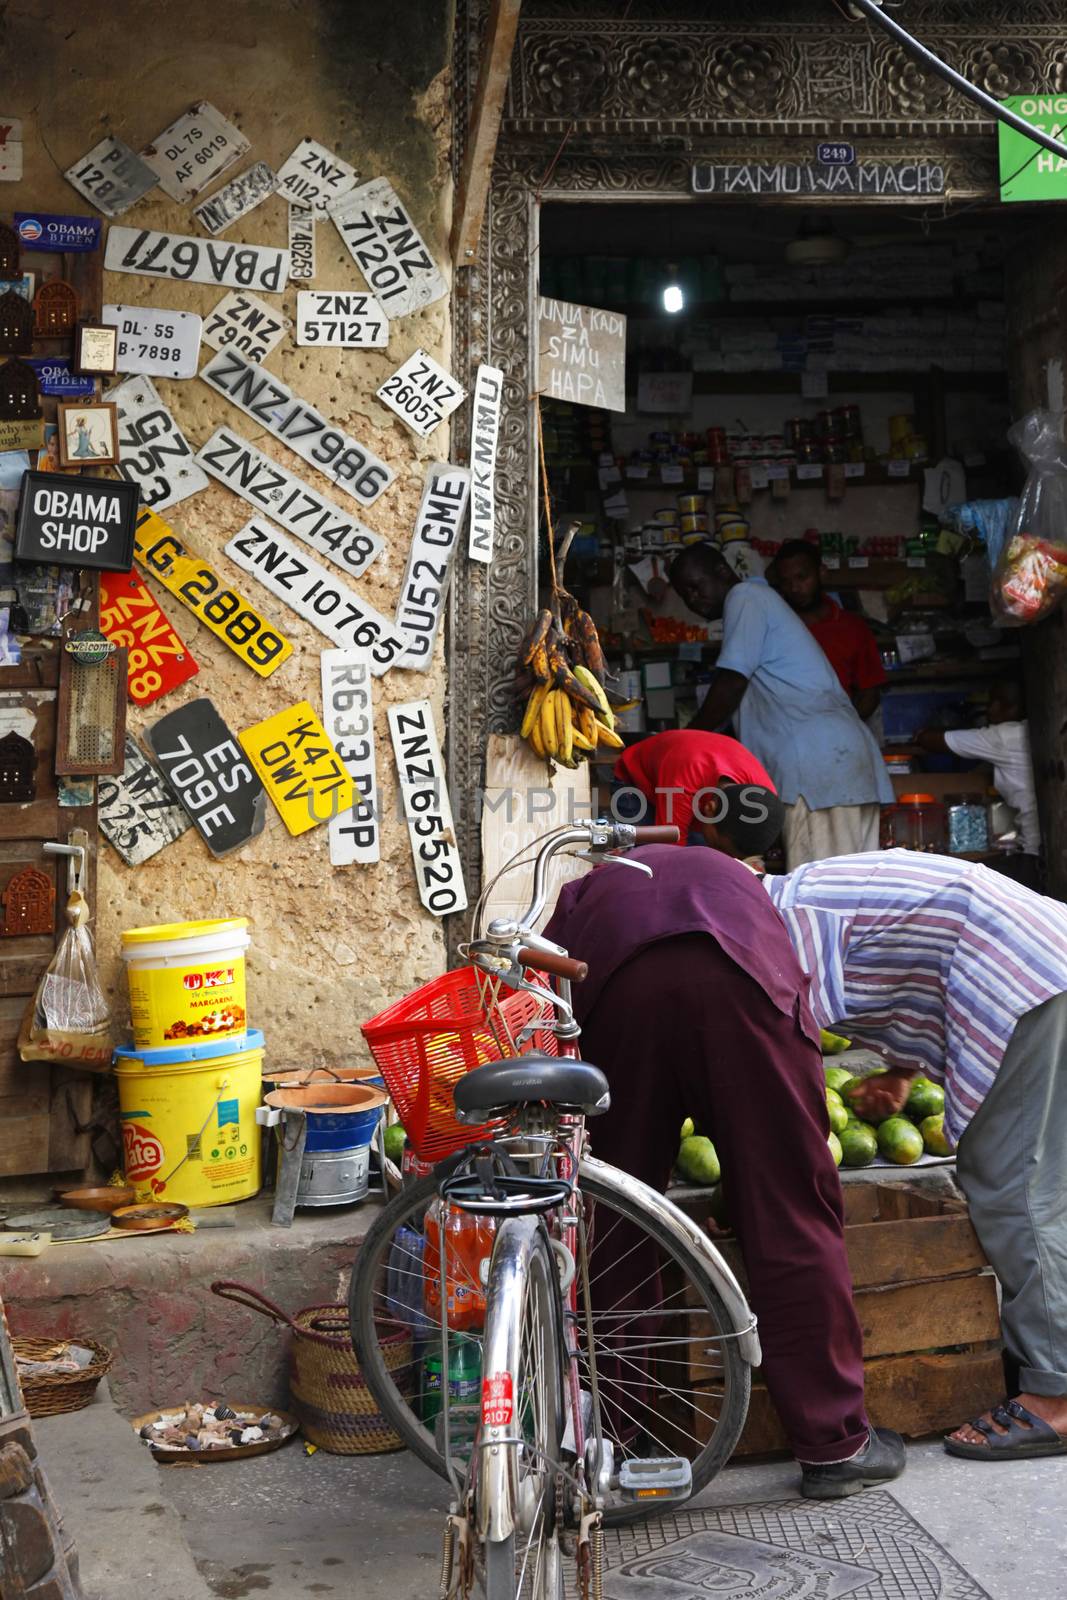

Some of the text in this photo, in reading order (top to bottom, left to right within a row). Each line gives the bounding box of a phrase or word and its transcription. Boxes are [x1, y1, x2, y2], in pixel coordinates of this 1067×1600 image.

[164, 127, 204, 162] DL 7S
[175, 134, 229, 183] AF 6019
[823, 147, 847, 160] 249
[300, 151, 346, 188] ZNZ
[691, 165, 800, 193] UTAMU
[859, 165, 944, 193] MACHO
[283, 173, 333, 211] 41123
[47, 222, 96, 236] OBAMA
[50, 233, 93, 244] BIDEN
[373, 206, 434, 279] ZNZ
[342, 210, 408, 300] 71201
[226, 297, 282, 343] ZNZ
[316, 295, 369, 316] ZNZ
[590, 309, 624, 338] KADI
[153, 324, 175, 339] 5S
[205, 314, 267, 363] 7906
[303, 321, 382, 342] 57127
[561, 326, 590, 349] ZA
[41, 366, 70, 377] OBA
[548, 336, 600, 369] SIMU
[45, 376, 88, 386] BIDEN
[407, 361, 456, 408] ZNZ
[551, 368, 608, 407] HAPA
[382, 376, 443, 431] 26057
[118, 409, 173, 507] 723
[135, 410, 191, 469] GZ
[33, 489, 122, 524] OBAMA
[40, 522, 109, 553] SHOP
[400, 475, 466, 656] GU52 GME
[233, 526, 403, 663] ZNZ 10765
[116, 586, 184, 667] ZNZ
[178, 569, 284, 666] 2889
[331, 665, 371, 763] R633
[203, 739, 253, 794] ES
[260, 740, 314, 802] OWV
[286, 717, 347, 796] K471
[158, 734, 237, 838] 709E
[183, 968, 235, 990] OKI
[484, 1410, 510, 1425] 2107
